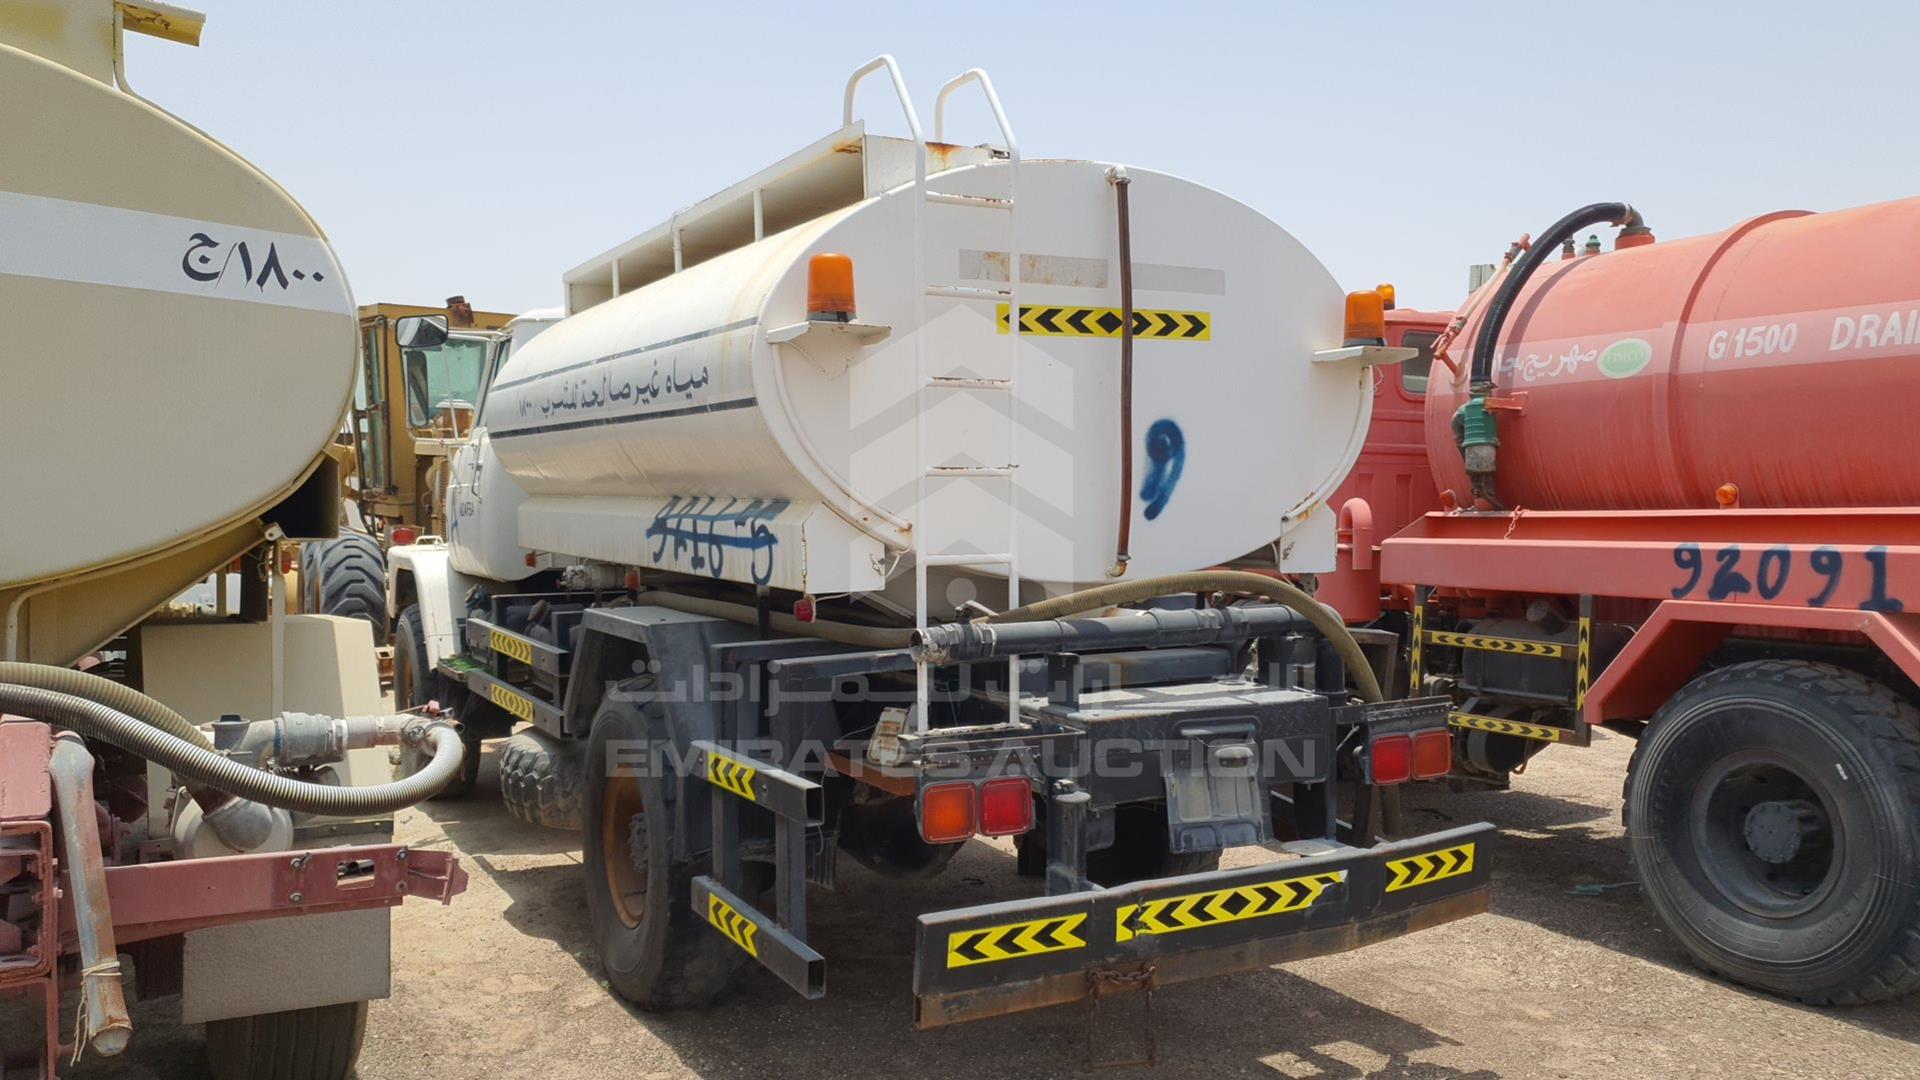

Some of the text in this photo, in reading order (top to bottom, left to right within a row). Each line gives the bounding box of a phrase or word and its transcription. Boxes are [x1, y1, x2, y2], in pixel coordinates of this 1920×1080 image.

[1829, 309, 1920, 352] DRAI
[634, 359, 660, 406] غير
[665, 357, 709, 400] مياه
[1671, 542, 1904, 612] 92091
